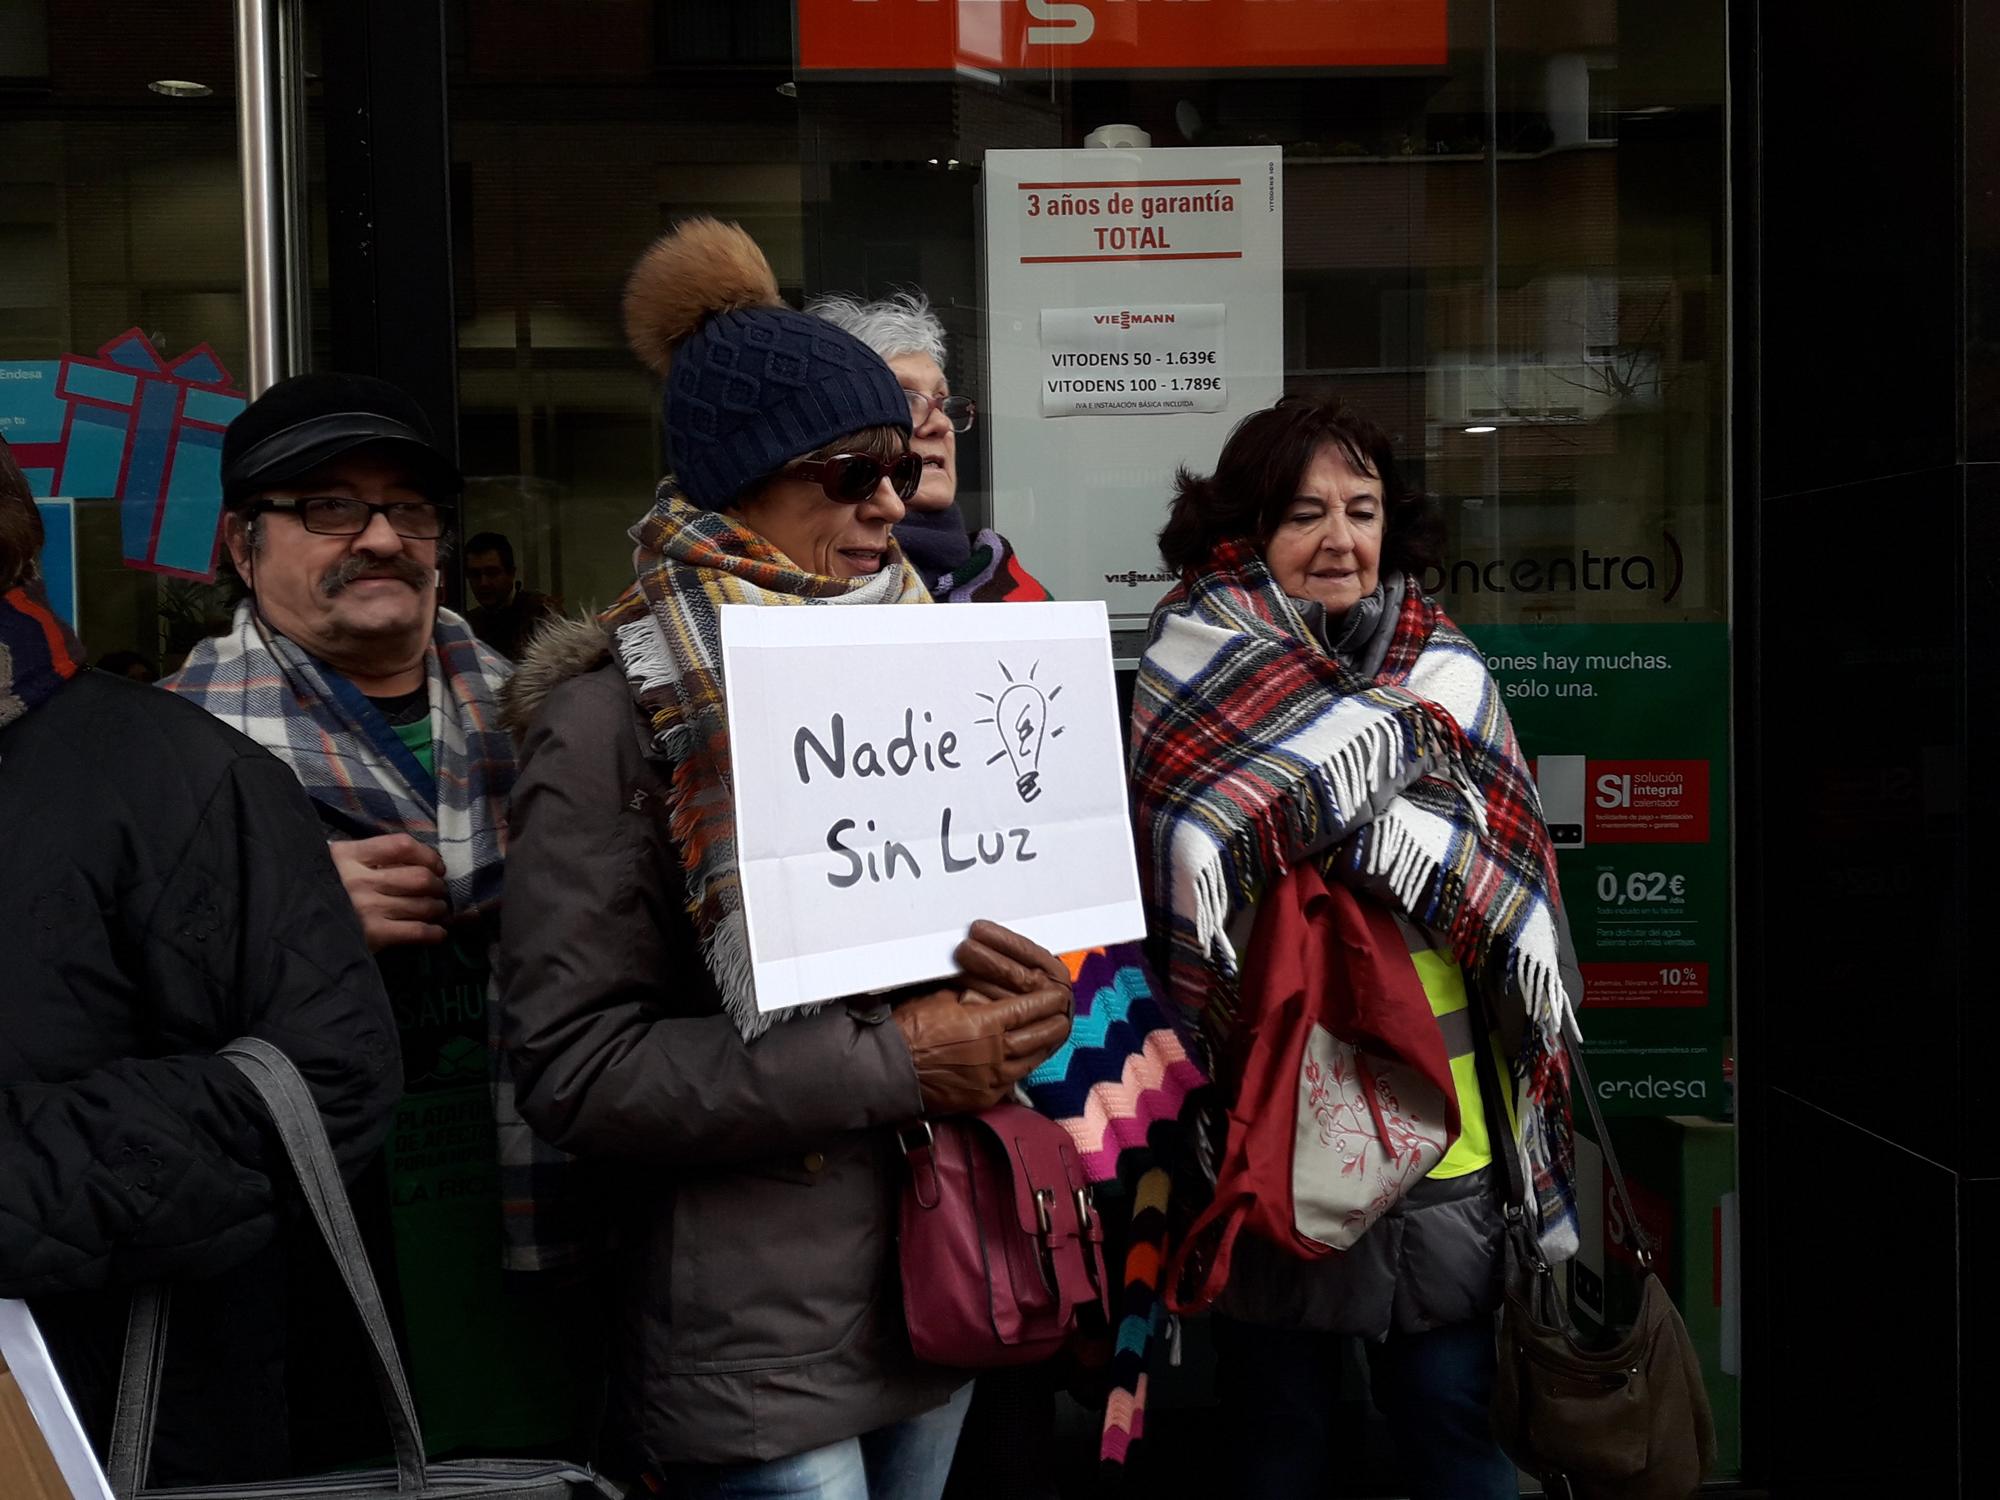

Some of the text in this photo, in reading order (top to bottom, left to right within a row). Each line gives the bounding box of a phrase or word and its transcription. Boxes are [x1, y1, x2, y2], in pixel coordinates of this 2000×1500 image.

[1026, 190, 1235, 220] 3 años de garantía
[1093, 227, 1171, 250] TOTAL
[1093, 311, 1176, 330] VIESSMANN
[1051, 352, 1130, 367] VITODENS
[1133, 352, 1152, 366] 50
[1166, 350, 1217, 365] 1.639€
[0, 369, 43, 380] Endesa
[1047, 379, 1126, 393] VITODENS
[1129, 378, 1157, 392] 100
[1170, 377, 1222, 392] 1.789€
[1138, 399, 1162, 408] BÁSICA
[1481, 650, 1673, 674] iones hay muchas.
[1505, 677, 1550, 698] sólo
[1554, 681, 1599, 698] una.
[793, 706, 961, 786] Nadie
[1633, 771, 1684, 783] solución
[1595, 773, 1631, 809] SI
[1633, 784, 1684, 798] integral
[825, 806, 1038, 889] Sin Luz
[1597, 1074, 1708, 1100] endesa
